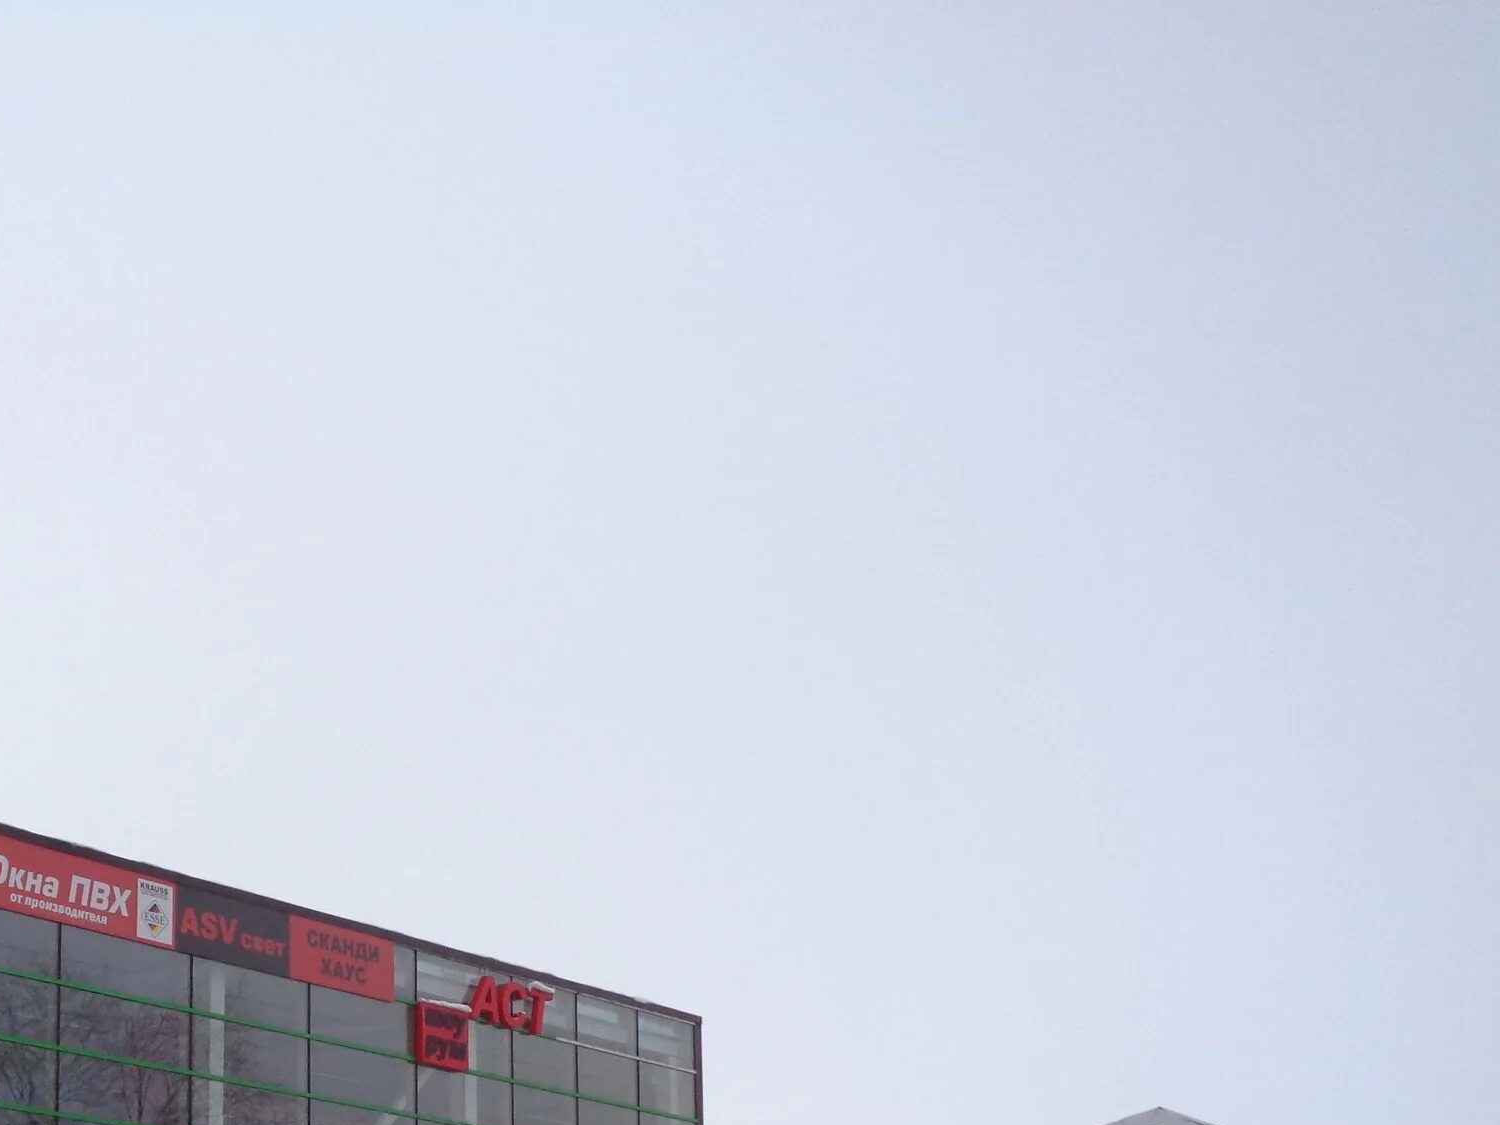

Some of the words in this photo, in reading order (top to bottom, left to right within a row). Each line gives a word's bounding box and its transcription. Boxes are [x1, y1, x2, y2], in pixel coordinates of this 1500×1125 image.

[69, 875, 132, 917] ПВХ
[140, 881, 168, 895] KRAUSS
[10, 893, 24, 904] от
[25, 896, 108, 926] производителя
[180, 907, 238, 945] ASV
[240, 932, 286, 958] свет
[320, 957, 367, 985] ХАУС
[469, 975, 555, 1035] АСТ
